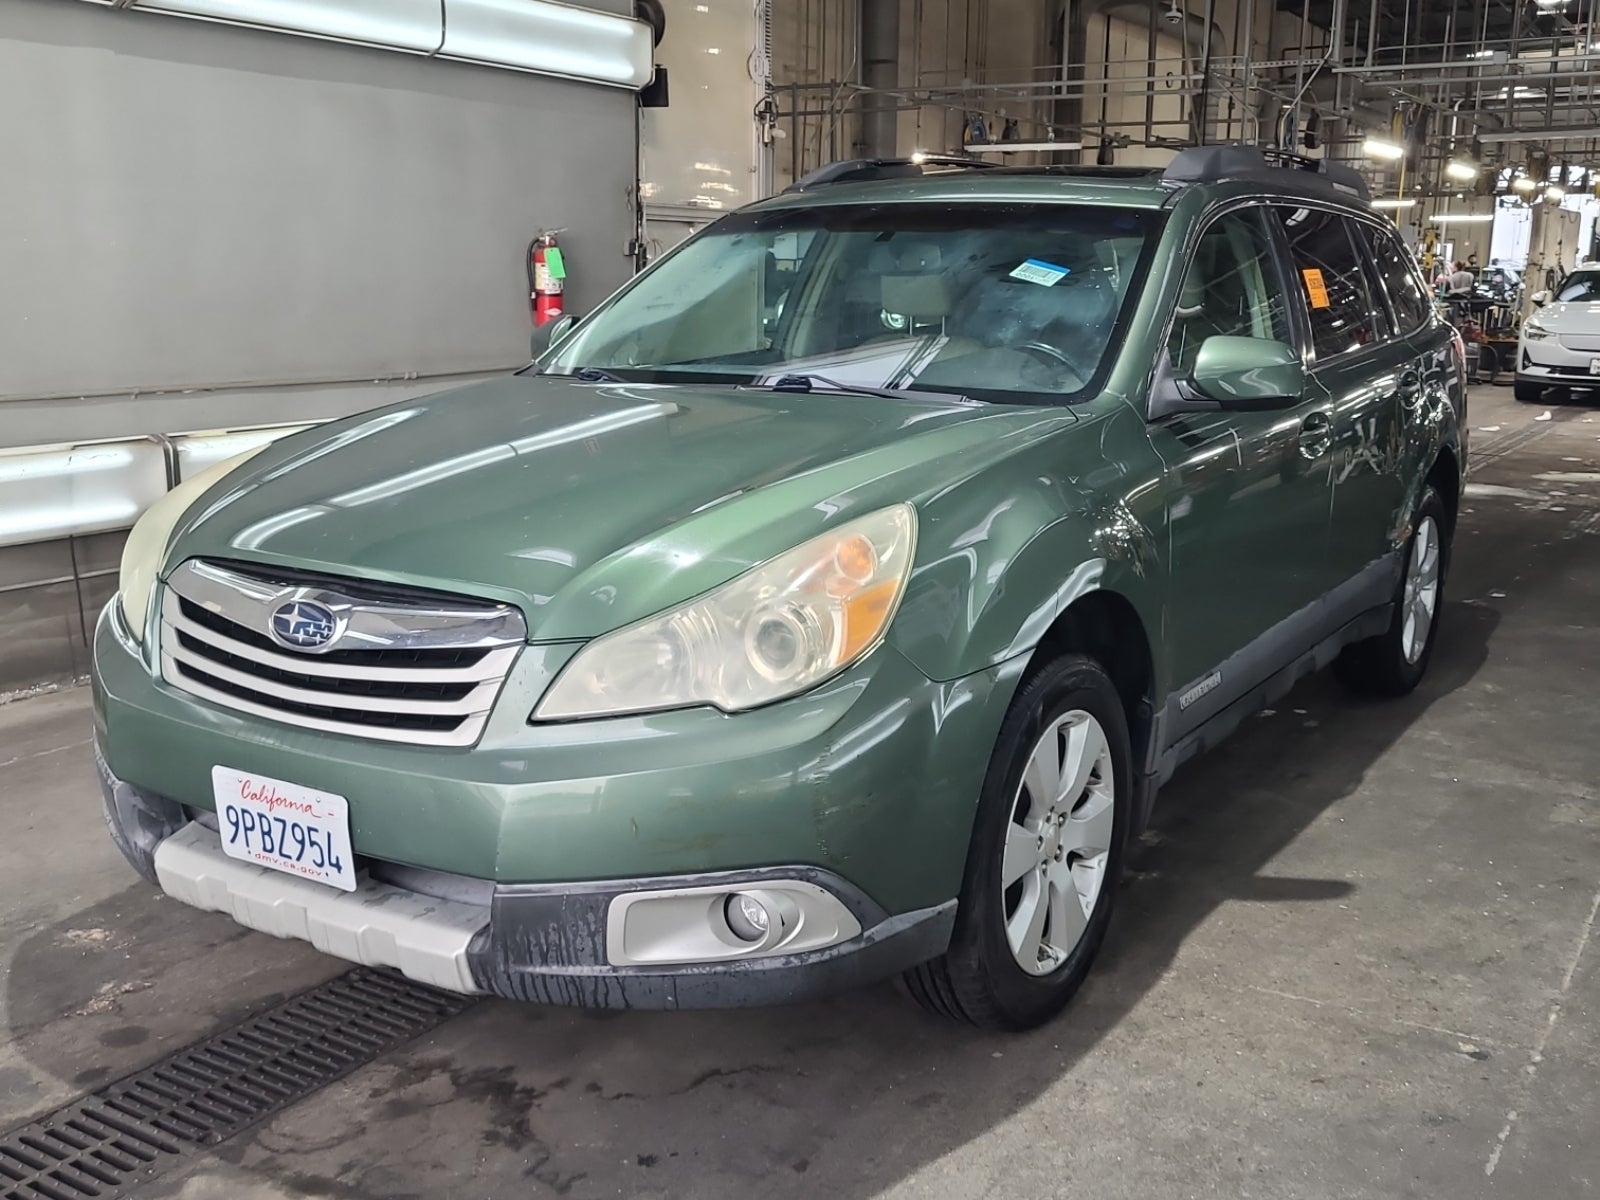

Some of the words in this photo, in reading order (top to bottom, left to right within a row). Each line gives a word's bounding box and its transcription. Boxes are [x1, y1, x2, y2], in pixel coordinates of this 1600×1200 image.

[240, 779, 322, 818] California
[226, 805, 342, 874] 9PBZ954
[254, 853, 322, 876] dmv.ca.gov
